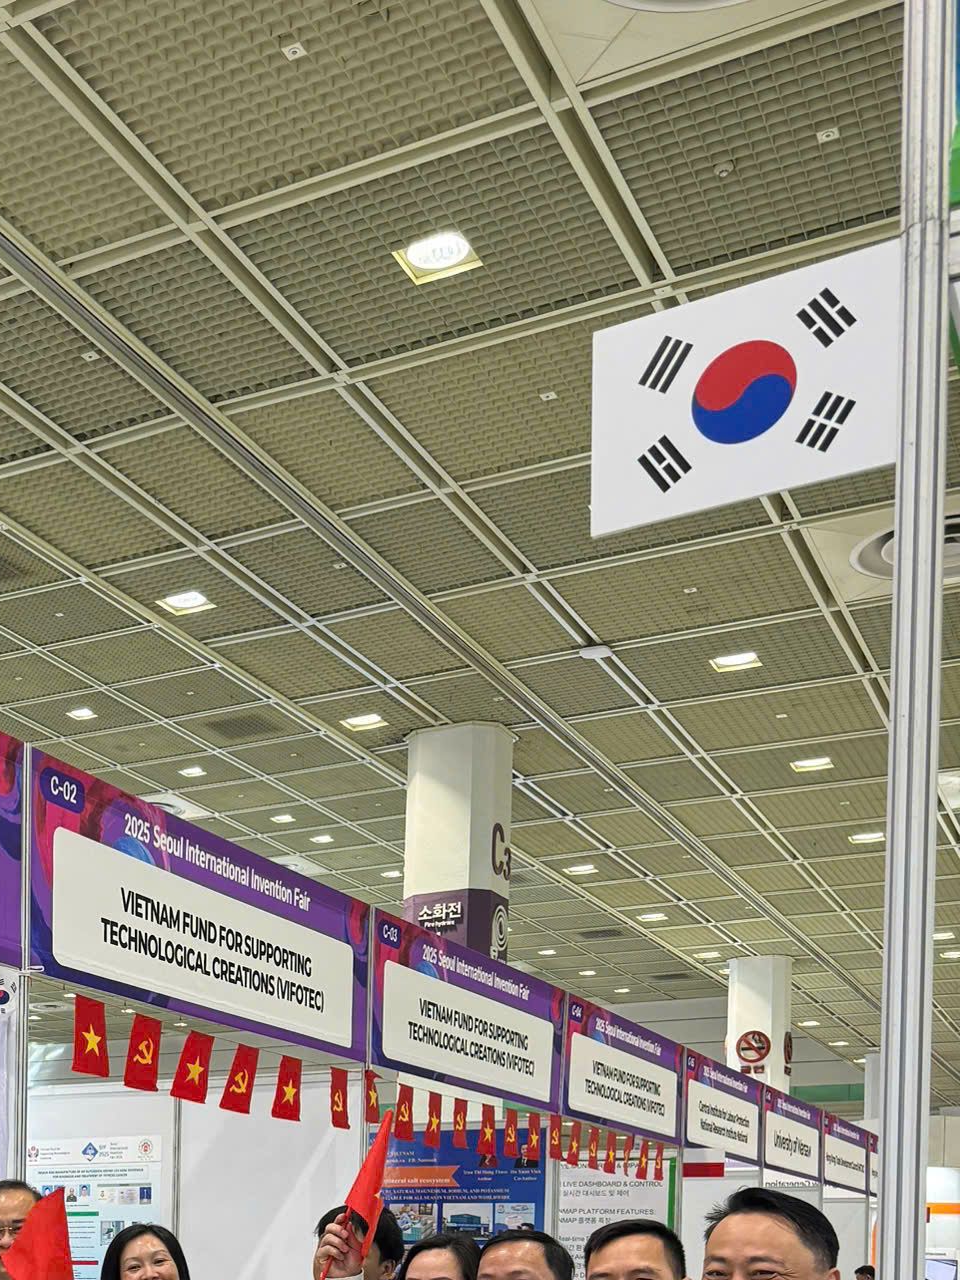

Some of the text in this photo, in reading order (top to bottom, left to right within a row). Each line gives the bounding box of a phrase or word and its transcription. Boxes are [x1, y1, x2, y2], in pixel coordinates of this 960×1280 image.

[50, 775, 77, 804] C-02
[125, 813, 310, 912] 2025 Seoul International Invention Fair
[492, 823, 511, 881] C3
[121, 887, 312, 978] VIETNAM FUND FOR SUPPORTING
[383, 925, 398, 942] C-03
[418, 902, 461, 920] 소화전
[101, 917, 324, 1013] TECHNOLOGICAL CREATIONS (VIFOTEC)
[422, 944, 530, 1000] 2025 Seoul International Invention Fair
[408, 1021, 469, 1056] TECHNOLOGICAL
[469, 1041, 506, 1067] CREATIONS
[420, 998, 528, 1051] VIETNAM FUND FOR SUPPORTING
